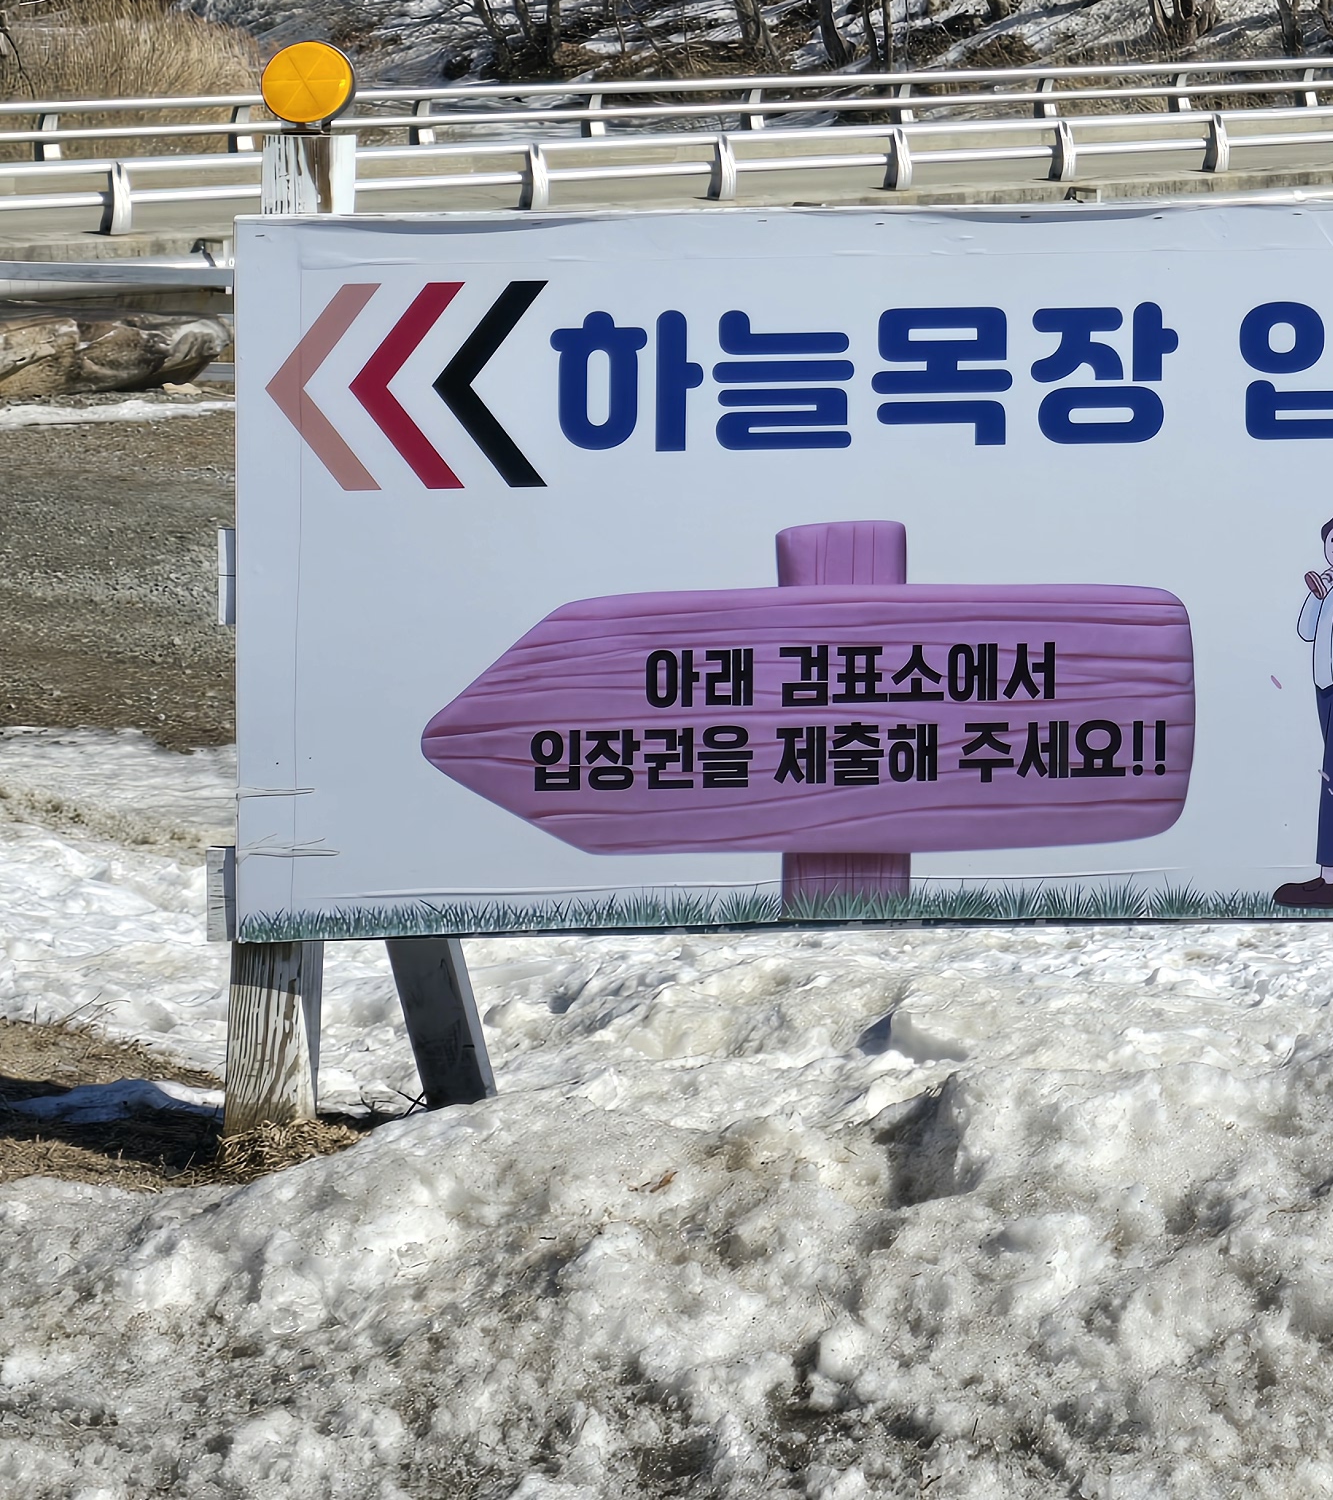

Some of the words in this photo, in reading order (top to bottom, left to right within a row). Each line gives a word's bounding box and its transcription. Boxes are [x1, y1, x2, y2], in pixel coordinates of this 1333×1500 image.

[551, 301, 1179, 452] 하늘목장
[645, 648, 754, 709] 아래
[779, 641, 1057, 708] 검표소에서
[530, 725, 754, 792] 입장권을
[773, 721, 939, 787] 제출해
[958, 719, 1167, 783] 주세요!!
